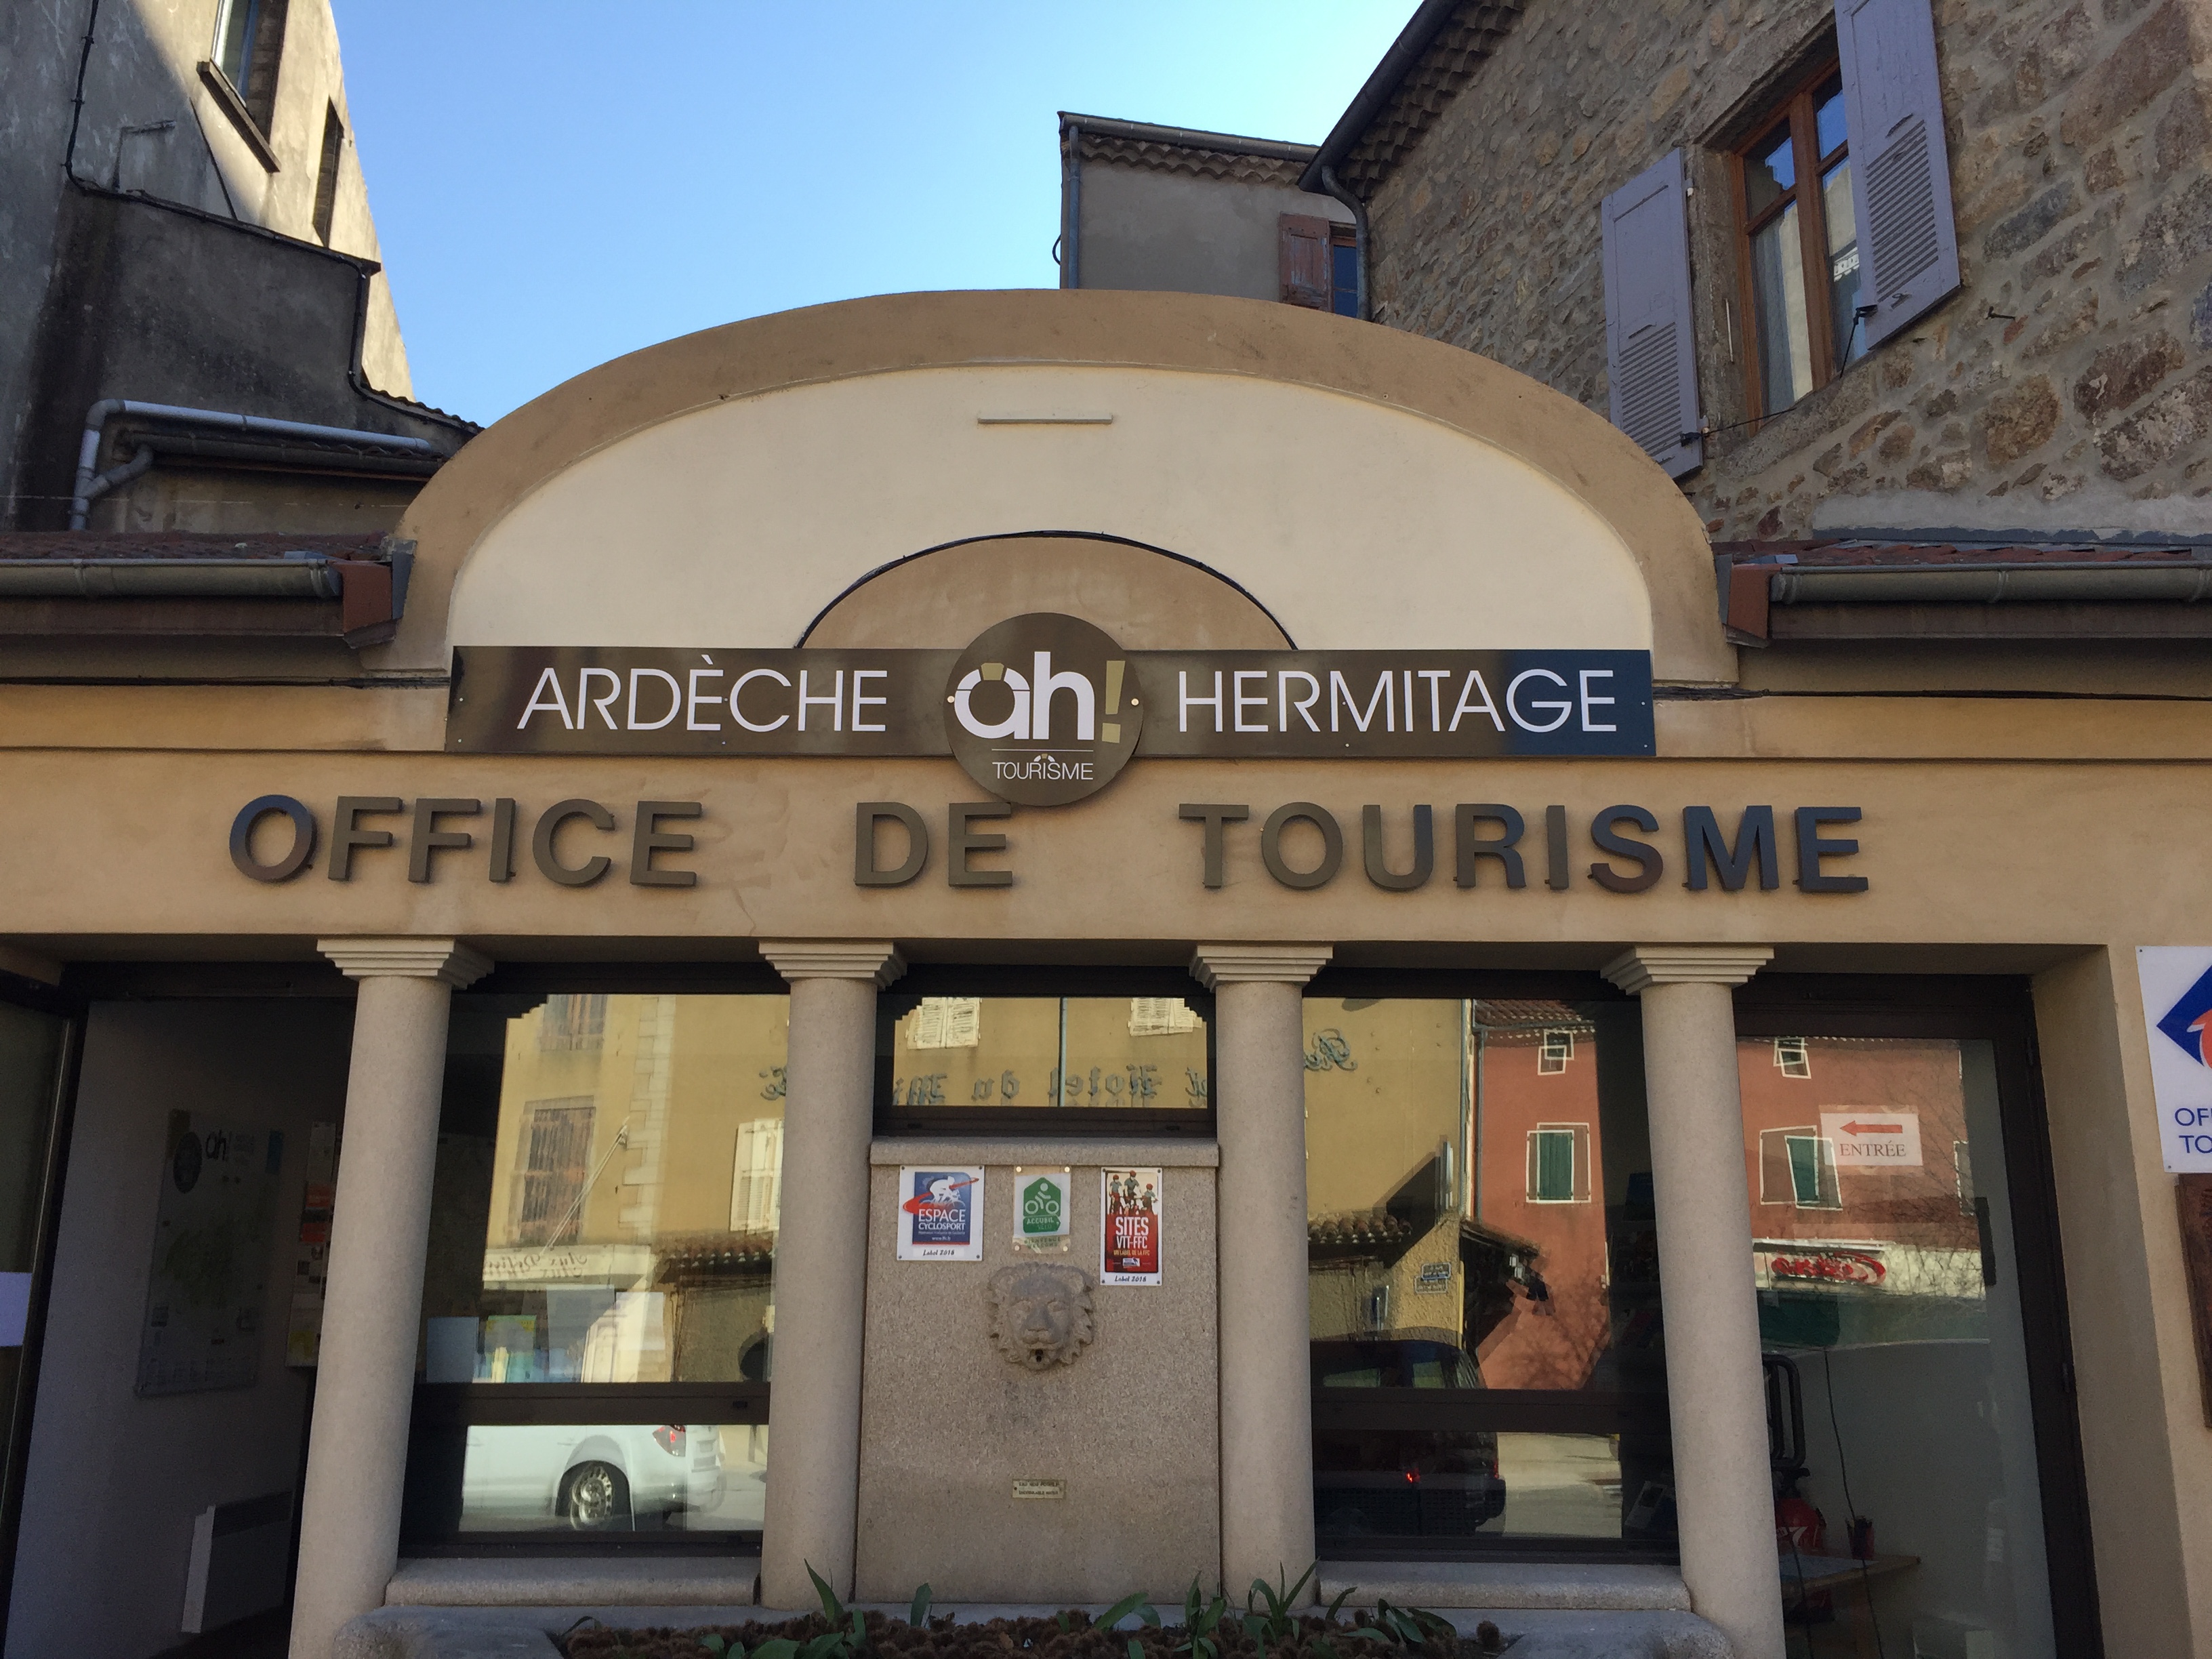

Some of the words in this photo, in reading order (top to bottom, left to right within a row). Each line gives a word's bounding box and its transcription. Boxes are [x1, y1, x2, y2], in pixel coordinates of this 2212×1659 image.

[517, 655, 887, 733] ARDÈCHE
[1179, 669, 1617, 733] HERMITAGE
[954, 651, 1126, 743] ah!
[991, 760, 1094, 781] TOURISME
[229, 794, 703, 886] OFFICE
[854, 801, 1012, 887] DE
[1178, 802, 1869, 893] TOURISME
[1839, 1140, 1906, 1157] ENTRÉE
[918, 1208, 966, 1222] ESPACE
[1027, 1216, 1054, 1225] ACCUEIL
[918, 1222, 966, 1231] CYCLOSPORT
[1116, 1216, 1149, 1236] SITES
[1116, 1236, 1148, 1249] VTT-FFC
[923, 1248, 939, 1256] Label
[1114, 1275, 1130, 1283] Label
